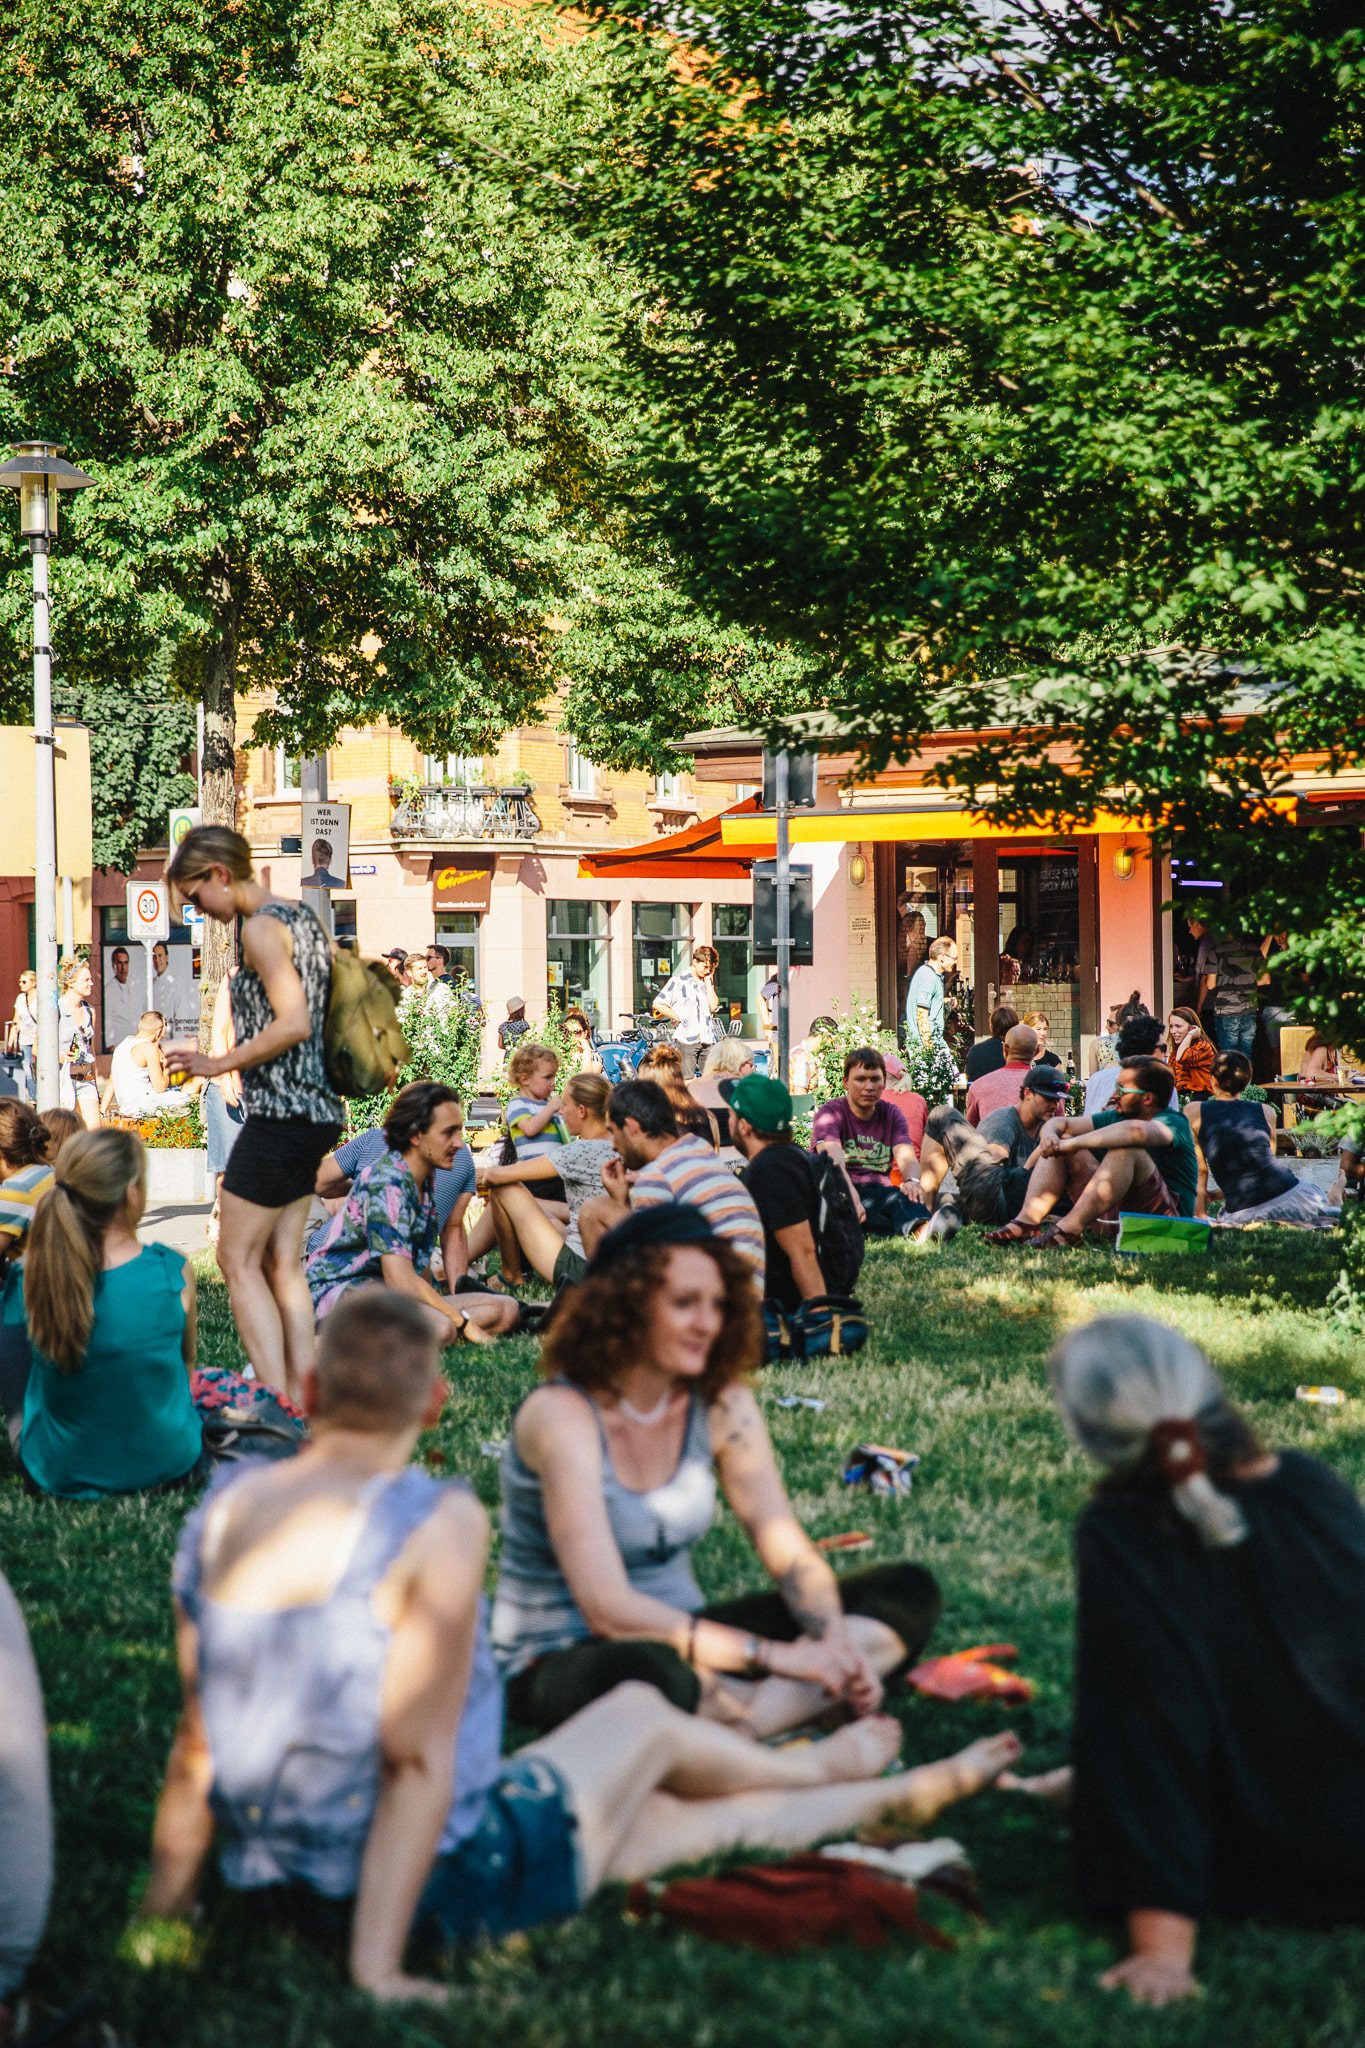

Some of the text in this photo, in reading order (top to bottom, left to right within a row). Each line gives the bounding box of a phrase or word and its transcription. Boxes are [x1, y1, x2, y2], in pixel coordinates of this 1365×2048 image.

[320, 818, 339, 826] DENN
[315, 828, 332, 836] DAS?
[142, 898, 155, 914] 30
[857, 1133, 877, 1145] REAL
